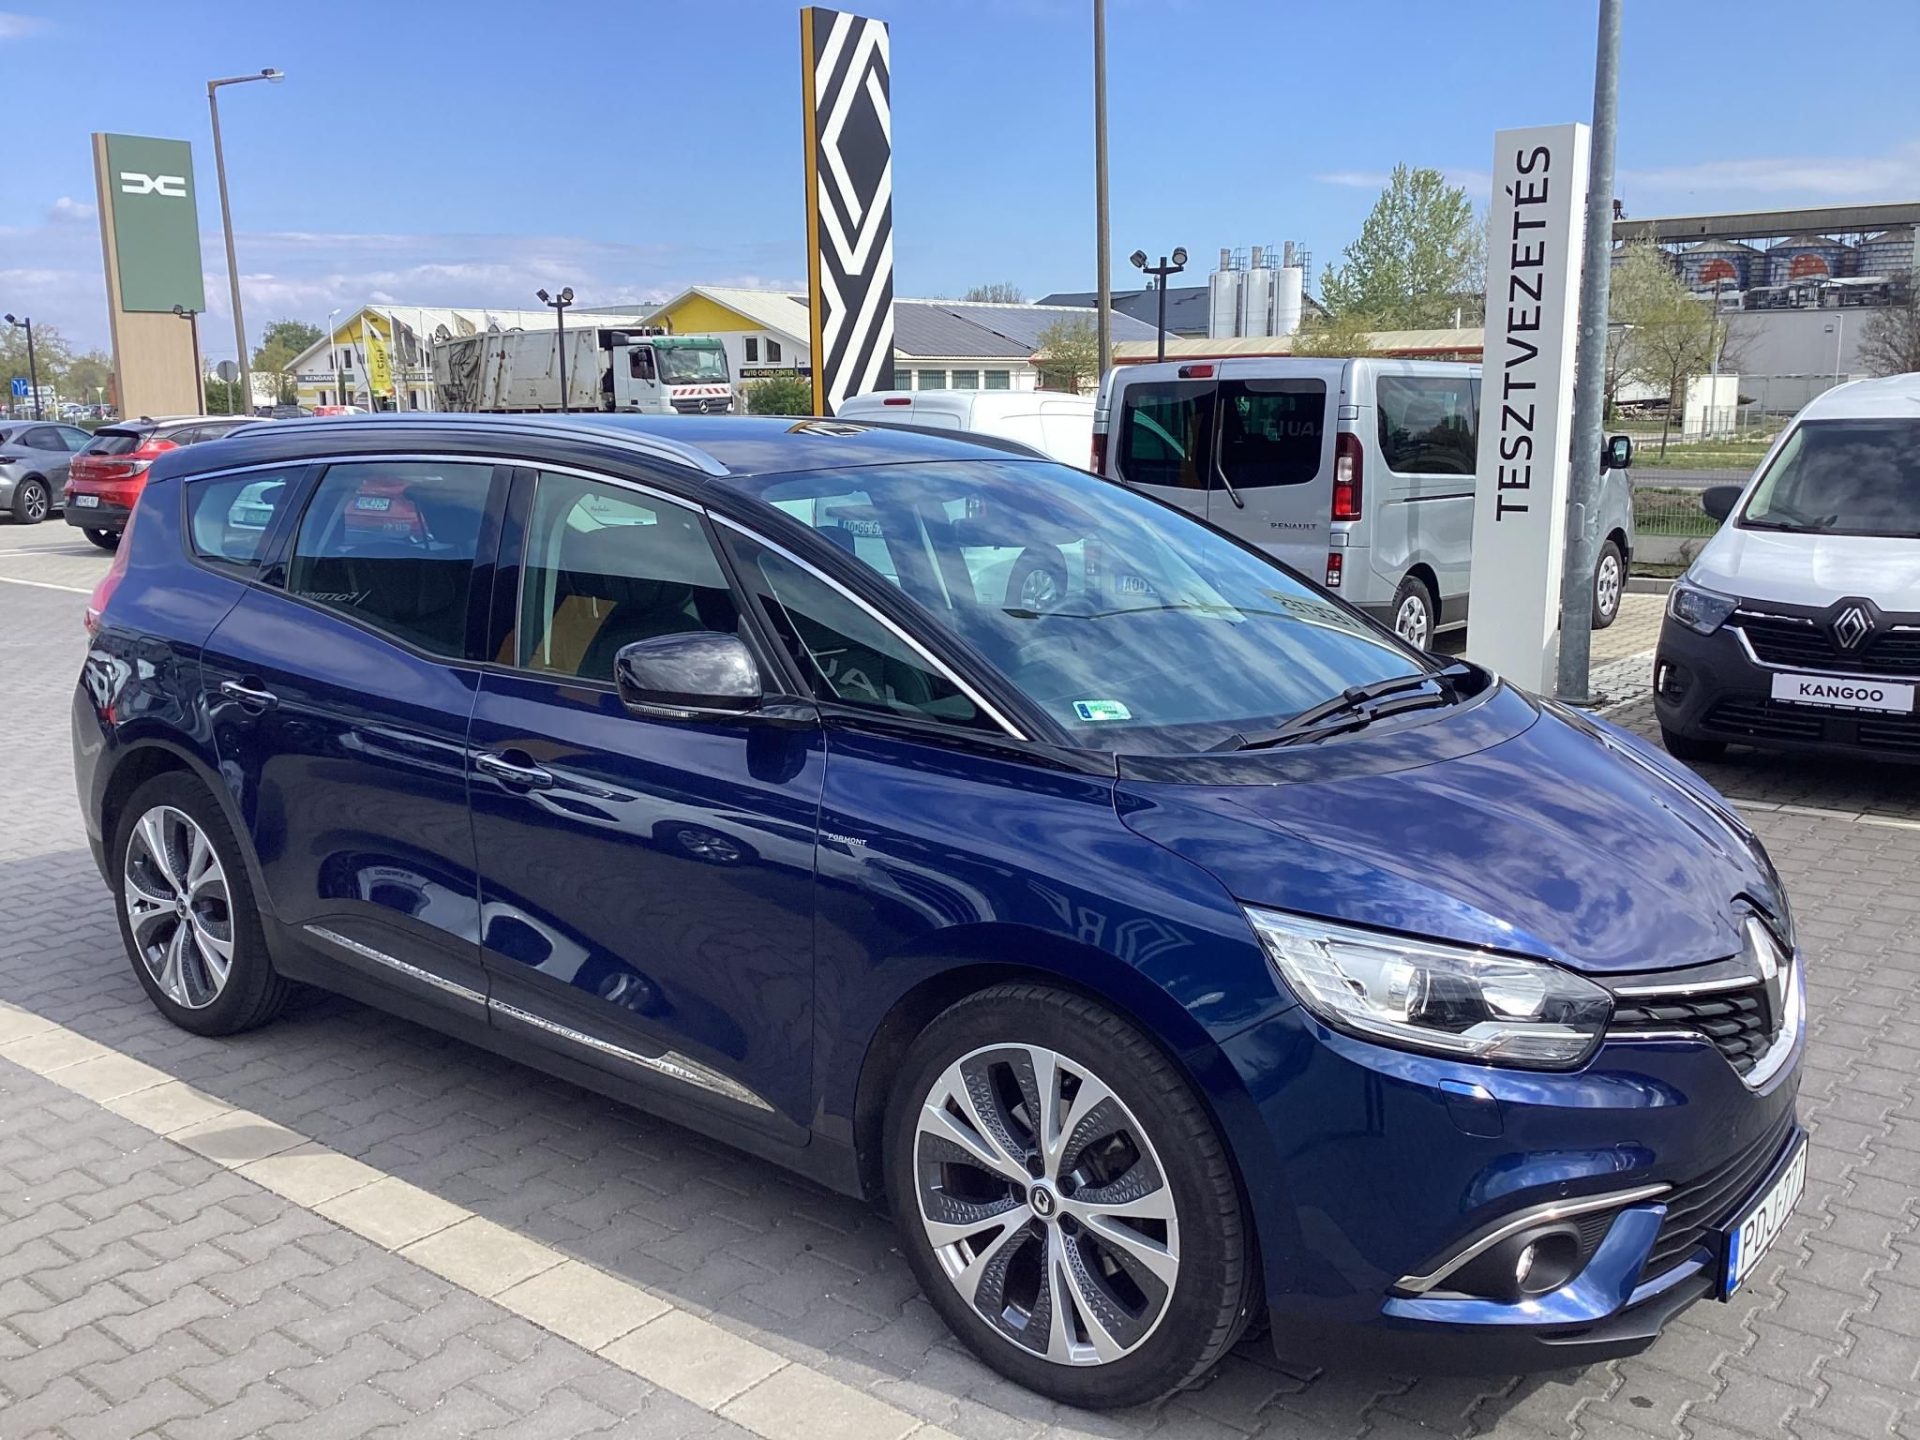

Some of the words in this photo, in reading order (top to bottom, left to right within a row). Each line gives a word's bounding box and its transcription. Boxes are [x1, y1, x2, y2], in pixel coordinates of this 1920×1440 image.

[1496, 145, 1551, 522] TESZTVEZETÉS
[1799, 683, 1884, 702] KANGOO
[828, 833, 867, 845] FORMONT
